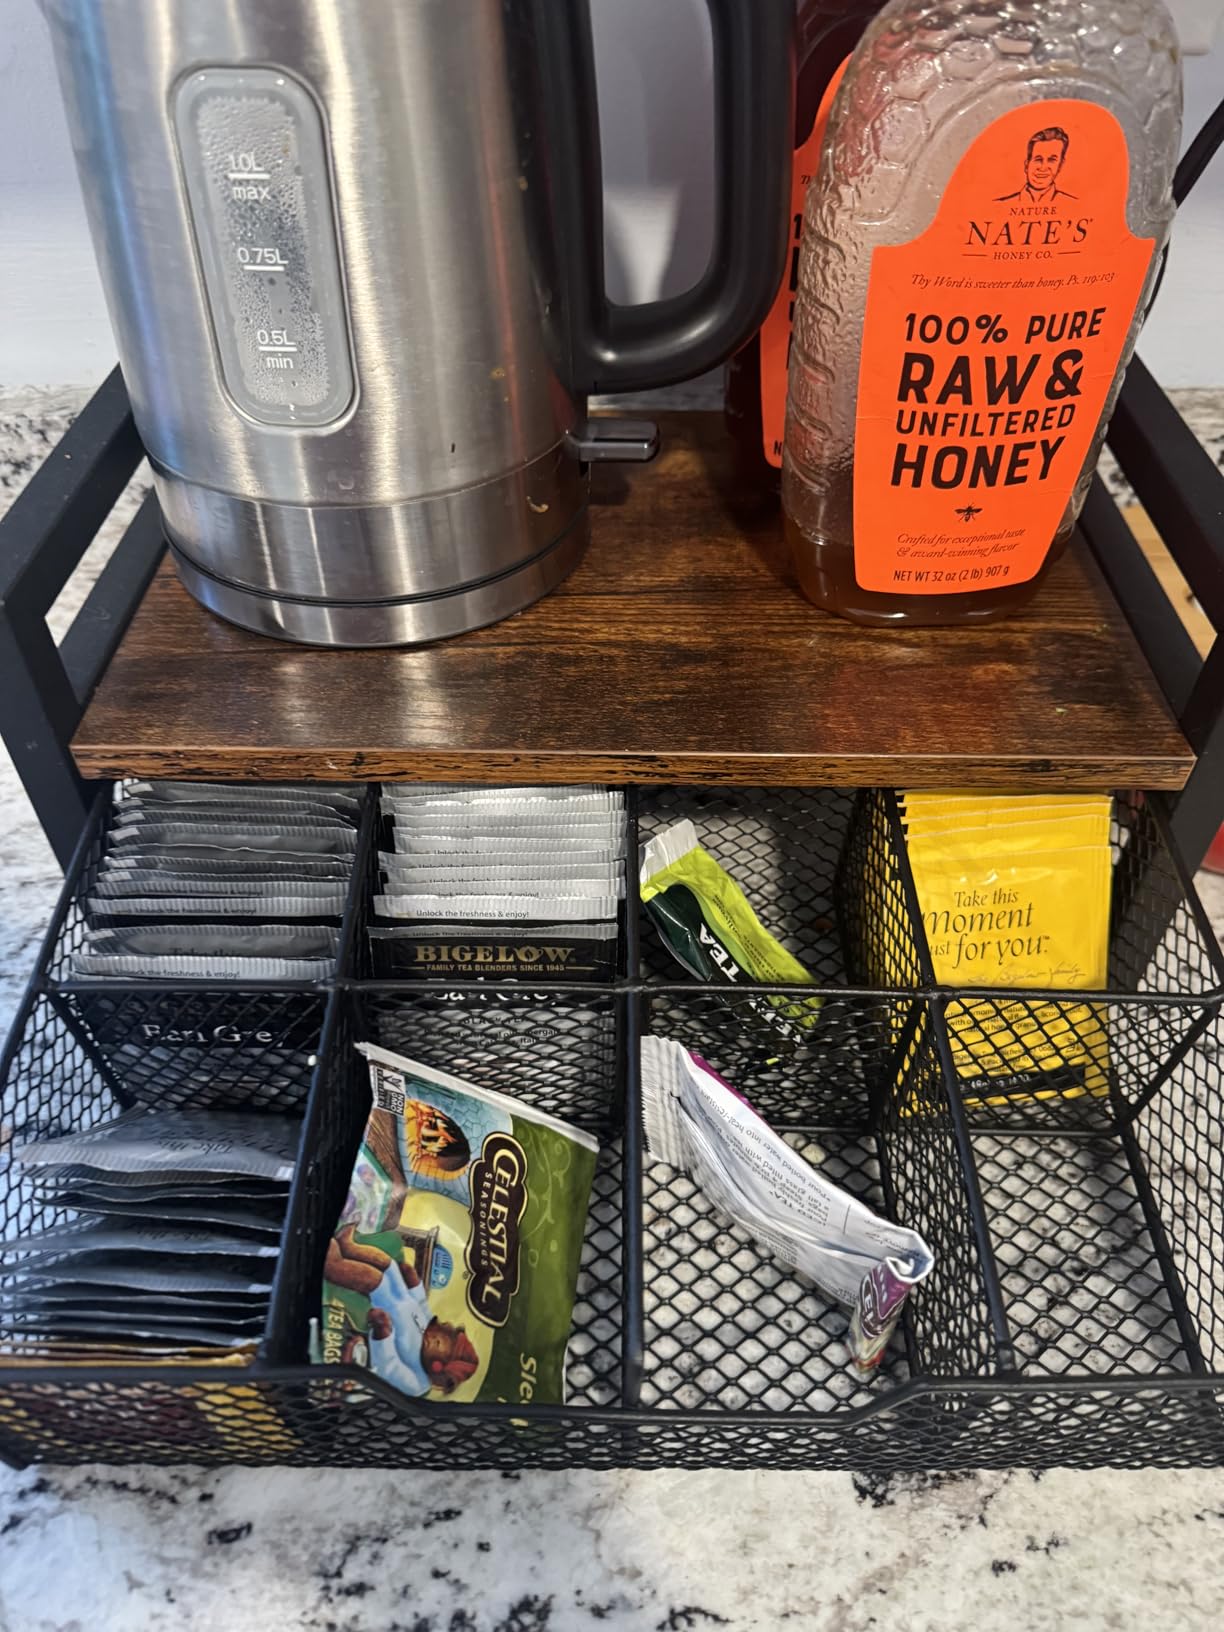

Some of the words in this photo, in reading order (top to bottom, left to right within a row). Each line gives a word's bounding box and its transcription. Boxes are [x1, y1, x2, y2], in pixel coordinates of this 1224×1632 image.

[232, 186, 272, 201] max
[1009, 206, 1057, 217] NATURE
[965, 218, 1089, 246] NATE'S
[237, 247, 289, 265] 0.75L
[993, 251, 1032, 261] HONEY
[1035, 250, 1053, 260] CO.
[911, 273, 930, 290] Thy
[934, 274, 966, 288] Word
[965, 277, 973, 289] is
[974, 278, 1012, 290] sweeter
[1011, 276, 1036, 289] than
[1037, 275, 1064, 291] honey.
[905, 313, 1009, 345] 100%
[1025, 307, 1106, 344] PURE
[257, 329, 296, 346] 0.5L
[267, 353, 294, 369] min
[897, 352, 1041, 406] RAW
[1044, 349, 1084, 400] &
[896, 404, 1075, 437] UNFILTERED
[891, 436, 1066, 489] HONEY
[897, 533, 934, 546] Crafted
[934, 534, 952, 547] for
[952, 529, 1006, 546] exceptional
[1006, 528, 1026, 539] taste
[910, 546, 988, 558] award-winning
[987, 542, 1020, 557] flavor
[894, 570, 912, 582] NET
[915, 571, 930, 582] WT
[932, 570, 943, 582] 32
[945, 572, 956, 581] oz
[958, 569, 969, 583] (2
[970, 567, 983, 580] lb)
[985, 565, 1003, 578] 907
[954, 890, 989, 908] Take
[993, 887, 1019, 905] this
[416, 909, 443, 917] Unlock
[505, 910, 529, 919] enjoy!
[415, 946, 575, 963] BIGELOW
[700, 922, 740, 983] TEA
[930, 940, 950, 957] ust
[952, 933, 993, 969] for
[426, 964, 455, 972] FAMILY
[457, 964, 472, 972] TEA
[475, 964, 518, 972] BLENDERS
[520, 964, 543, 972] SINCE
[546, 964, 565, 972] 1945
[396, 1094, 404, 1114] NON
[746, 1129, 762, 1143] into
[745, 1146, 762, 1162] with
[764, 1143, 782, 1161] water
[763, 1161, 783, 1181] filled
[782, 1160, 806, 1183] boiled
[786, 1178, 807, 1197] glass
[808, 1196, 822, 1207] tall
[480, 1171, 493, 1268] SEASONINGS
[481, 1149, 520, 1305] CELESTIAL
